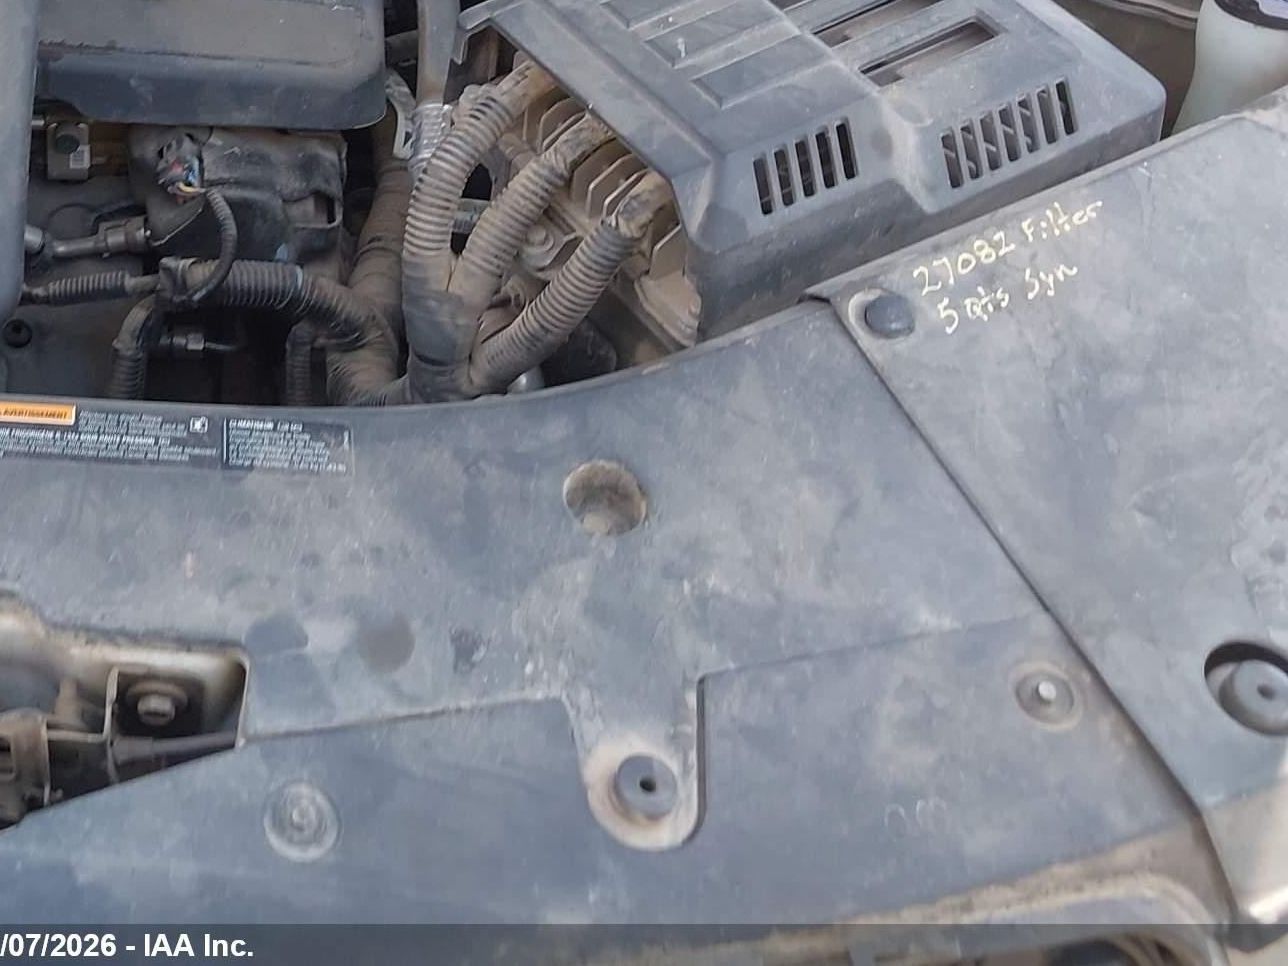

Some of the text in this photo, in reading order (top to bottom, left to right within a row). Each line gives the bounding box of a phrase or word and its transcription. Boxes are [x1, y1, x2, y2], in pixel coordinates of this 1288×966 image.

[912, 200, 1104, 297] 27082 Filter
[937, 297, 959, 335] 5
